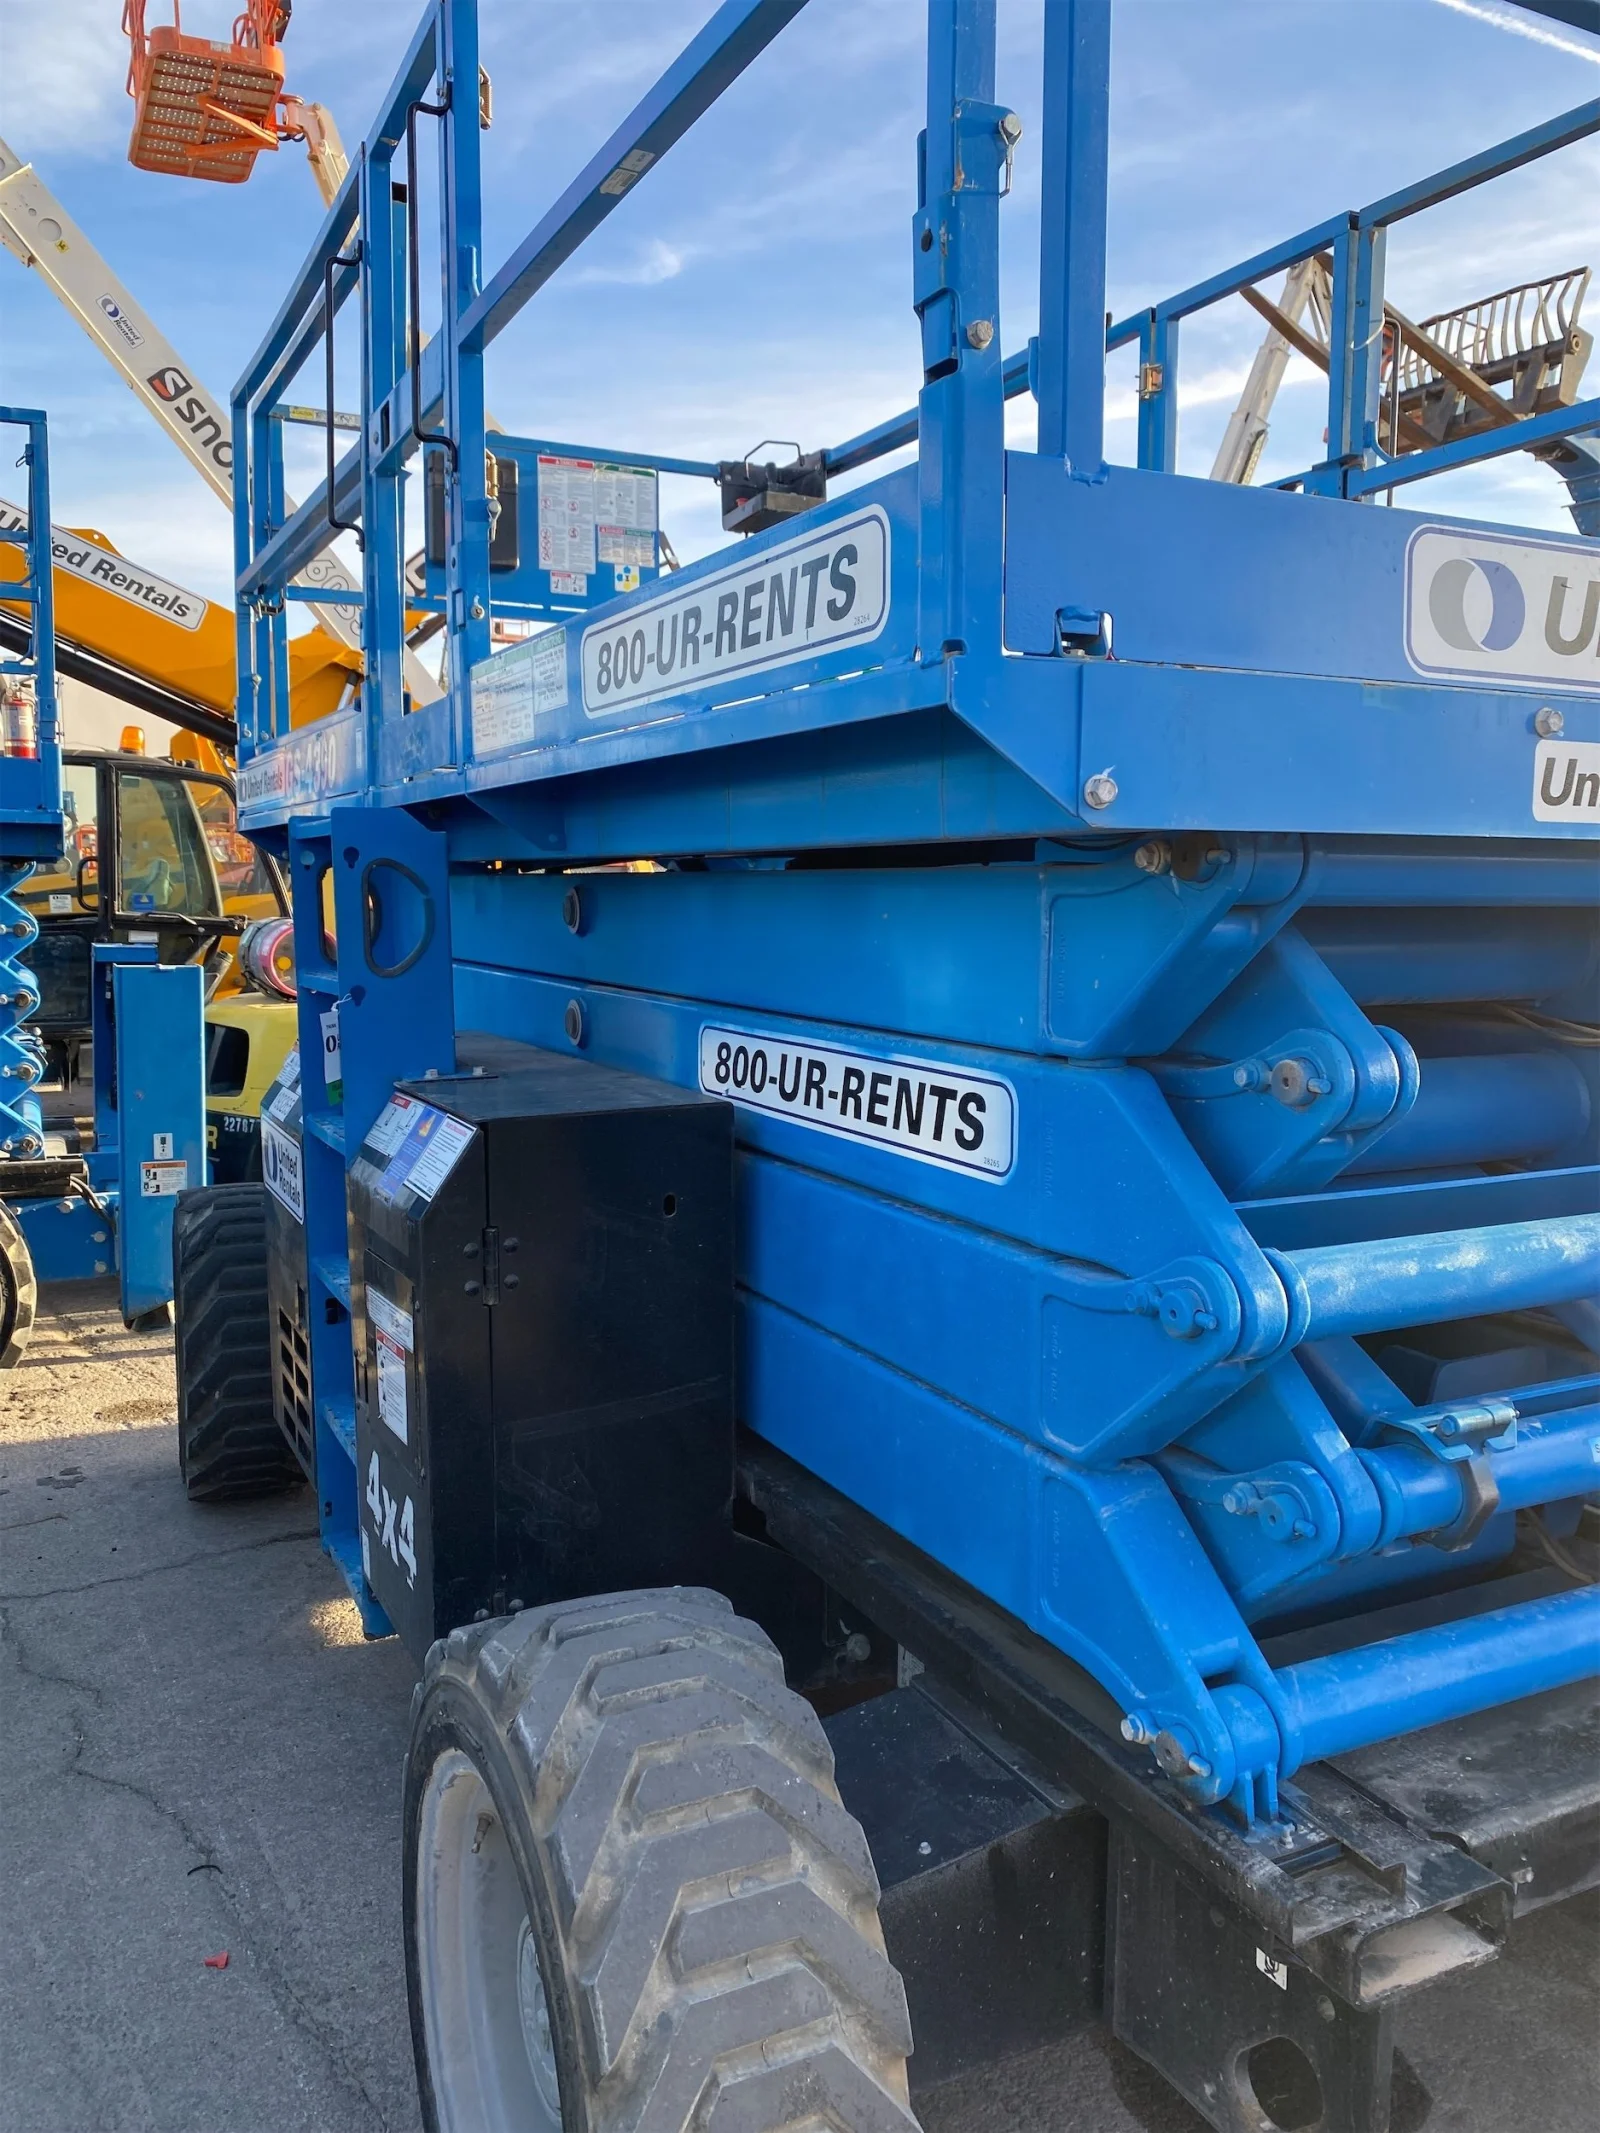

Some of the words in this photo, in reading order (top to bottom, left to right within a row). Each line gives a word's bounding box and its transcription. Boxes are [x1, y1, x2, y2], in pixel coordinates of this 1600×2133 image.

[113, 319, 136, 347] Rentals
[119, 316, 142, 342] United
[90, 557, 191, 619] Rentals
[596, 543, 859, 695] 800-UR-RENTS
[1540, 757, 1600, 807] Un
[714, 1041, 987, 1152] 800-UR-RENTS
[278, 1141, 299, 1180] United
[278, 1172, 302, 1208] Rentals
